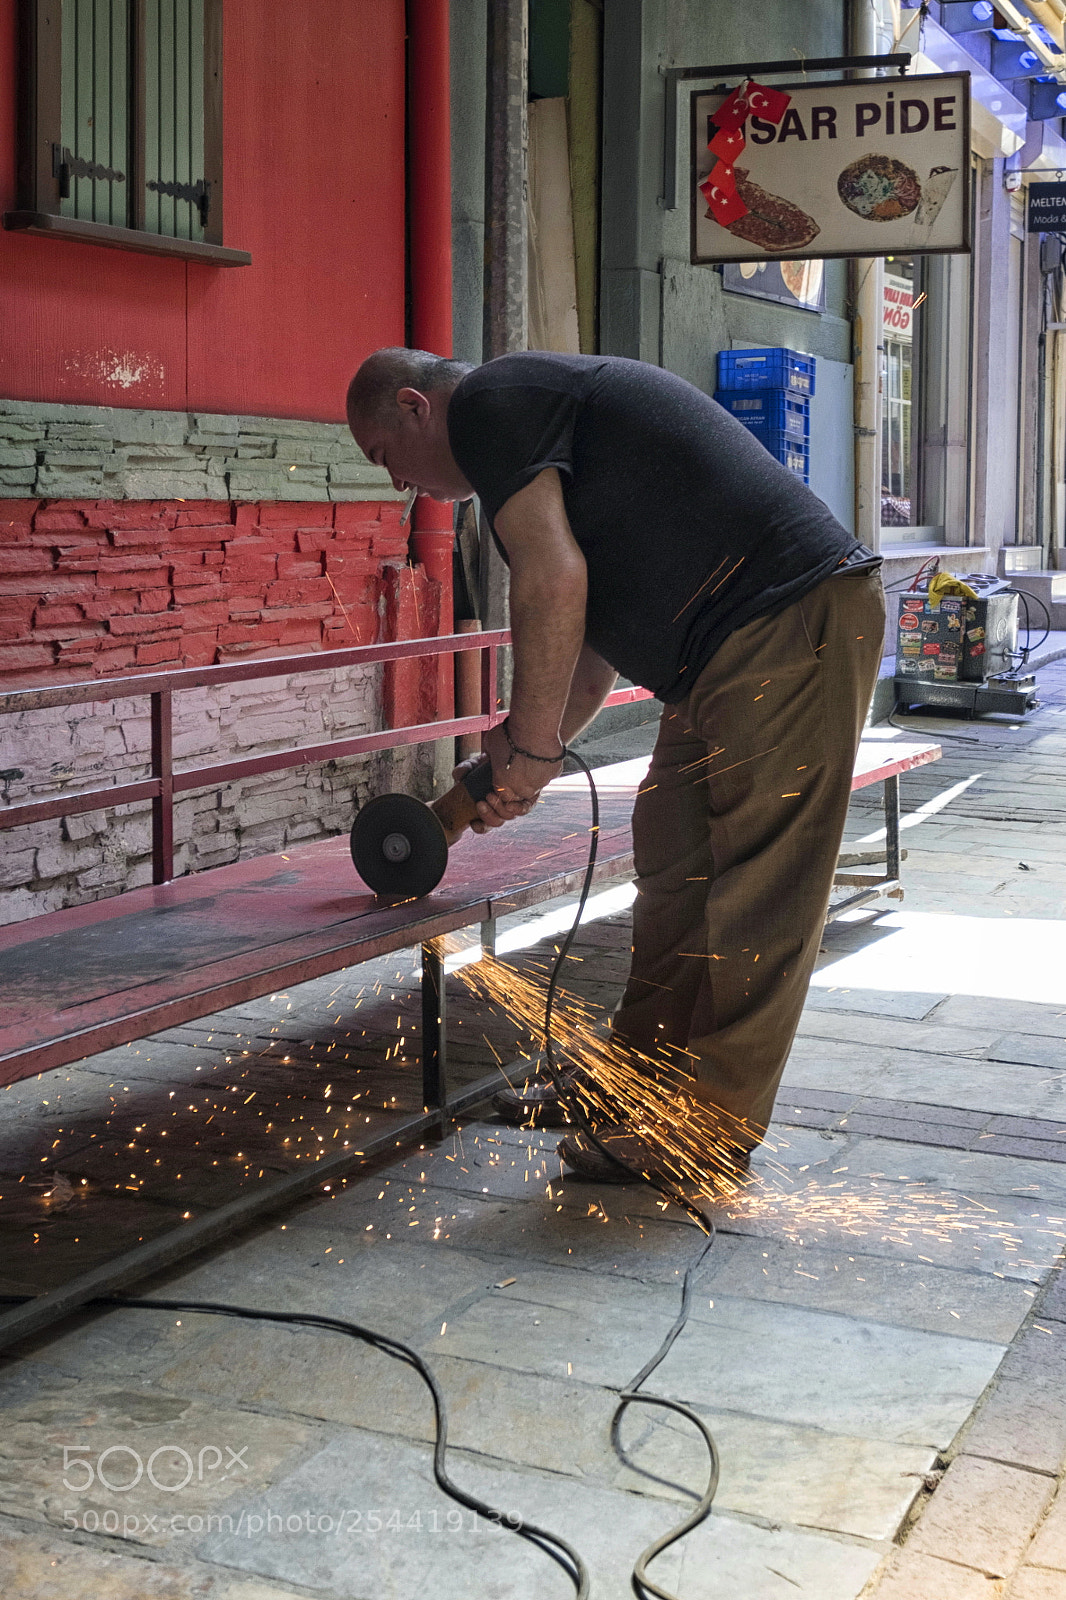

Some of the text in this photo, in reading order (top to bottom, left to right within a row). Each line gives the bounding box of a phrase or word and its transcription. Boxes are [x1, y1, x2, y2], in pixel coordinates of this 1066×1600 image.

[706, 91, 957, 147] SAR PİDE
[1034, 215, 1059, 223] Moda
